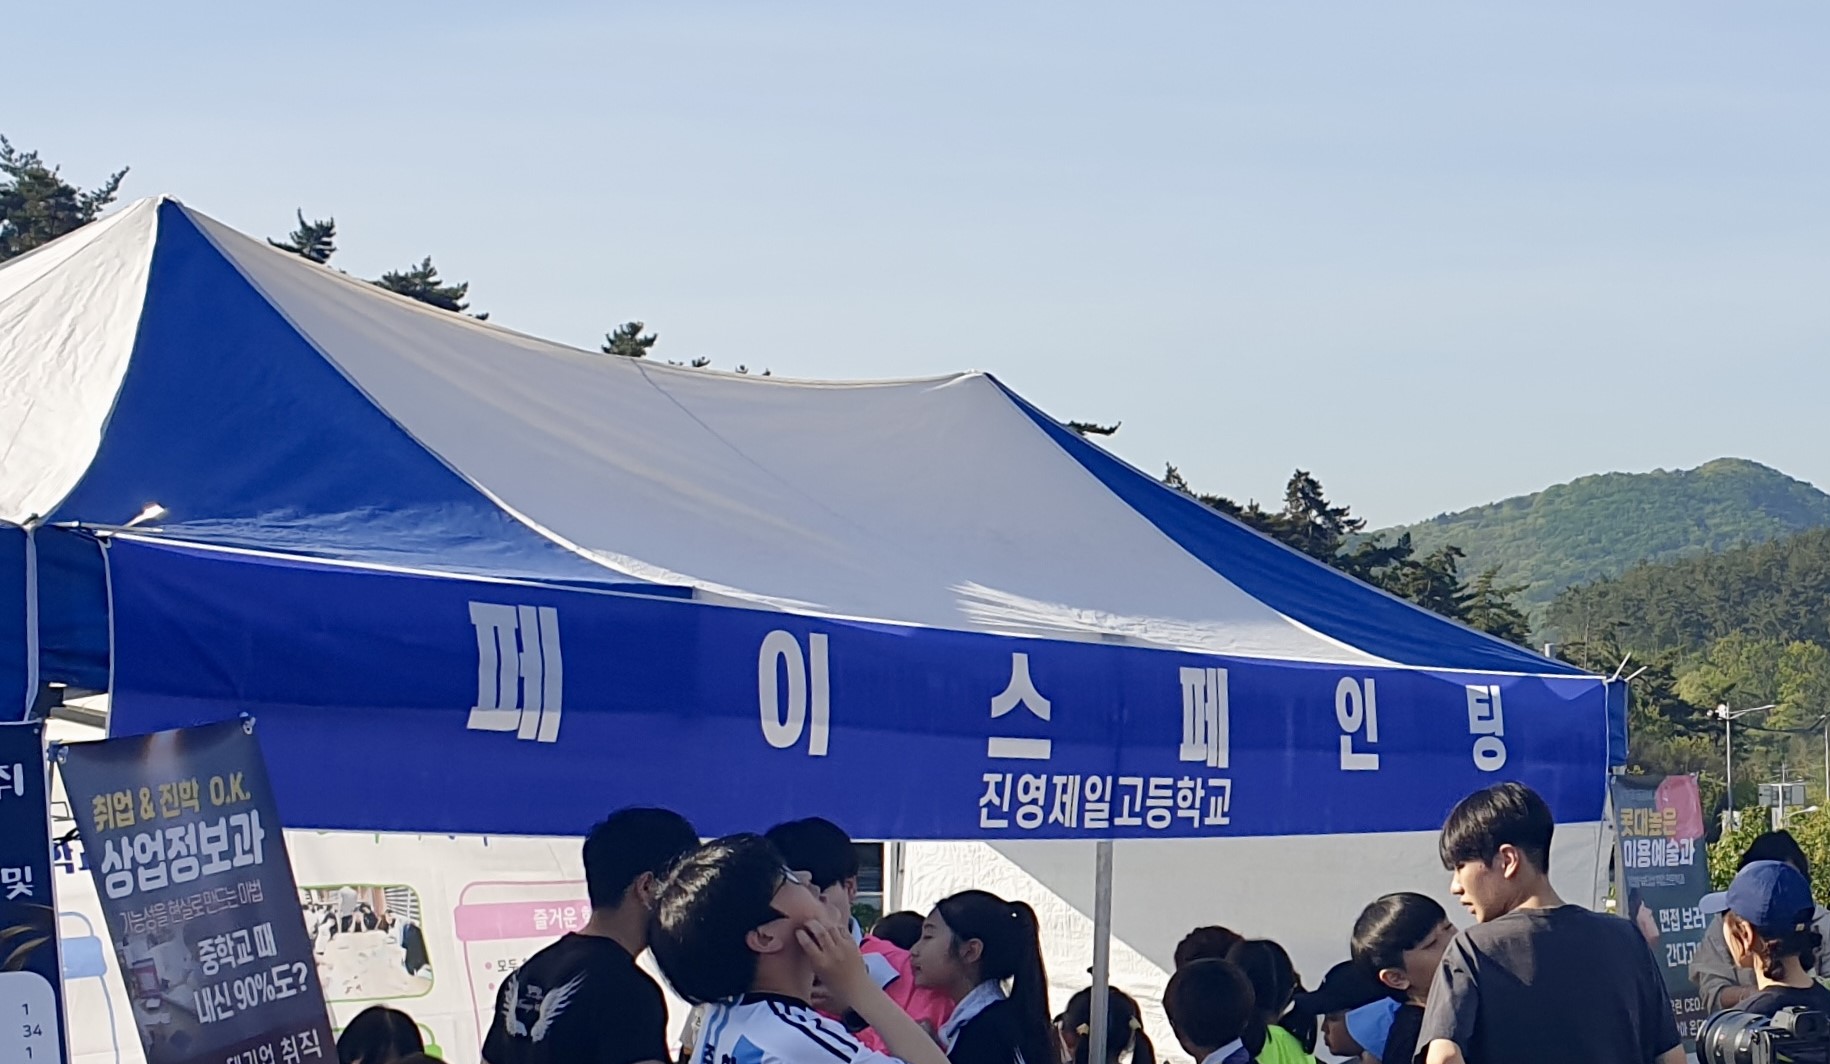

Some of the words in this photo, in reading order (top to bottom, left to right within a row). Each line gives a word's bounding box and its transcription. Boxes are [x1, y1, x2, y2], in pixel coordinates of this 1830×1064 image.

[92, 789, 135, 832] 취업
[139, 786, 155, 820] &
[158, 777, 199, 819] 진학
[209, 771, 251, 807] O.K.
[978, 773, 1232, 829] 진영제일고등학교
[101, 808, 265, 899] 상업정보과
[1623, 837, 1696, 869] 미용예술과
[0, 865, 35, 900] 및
[533, 906, 577, 931] 즐거운
[1658, 907, 1681, 933] 면접
[198, 929, 254, 976] 중학교
[253, 921, 278, 960] 때
[22, 1003, 30, 1016] 1
[194, 981, 234, 1025] 내신
[233, 961, 309, 1011] 90%도?
[22, 1024, 42, 1038] 34
[25, 1046, 33, 1060] 1
